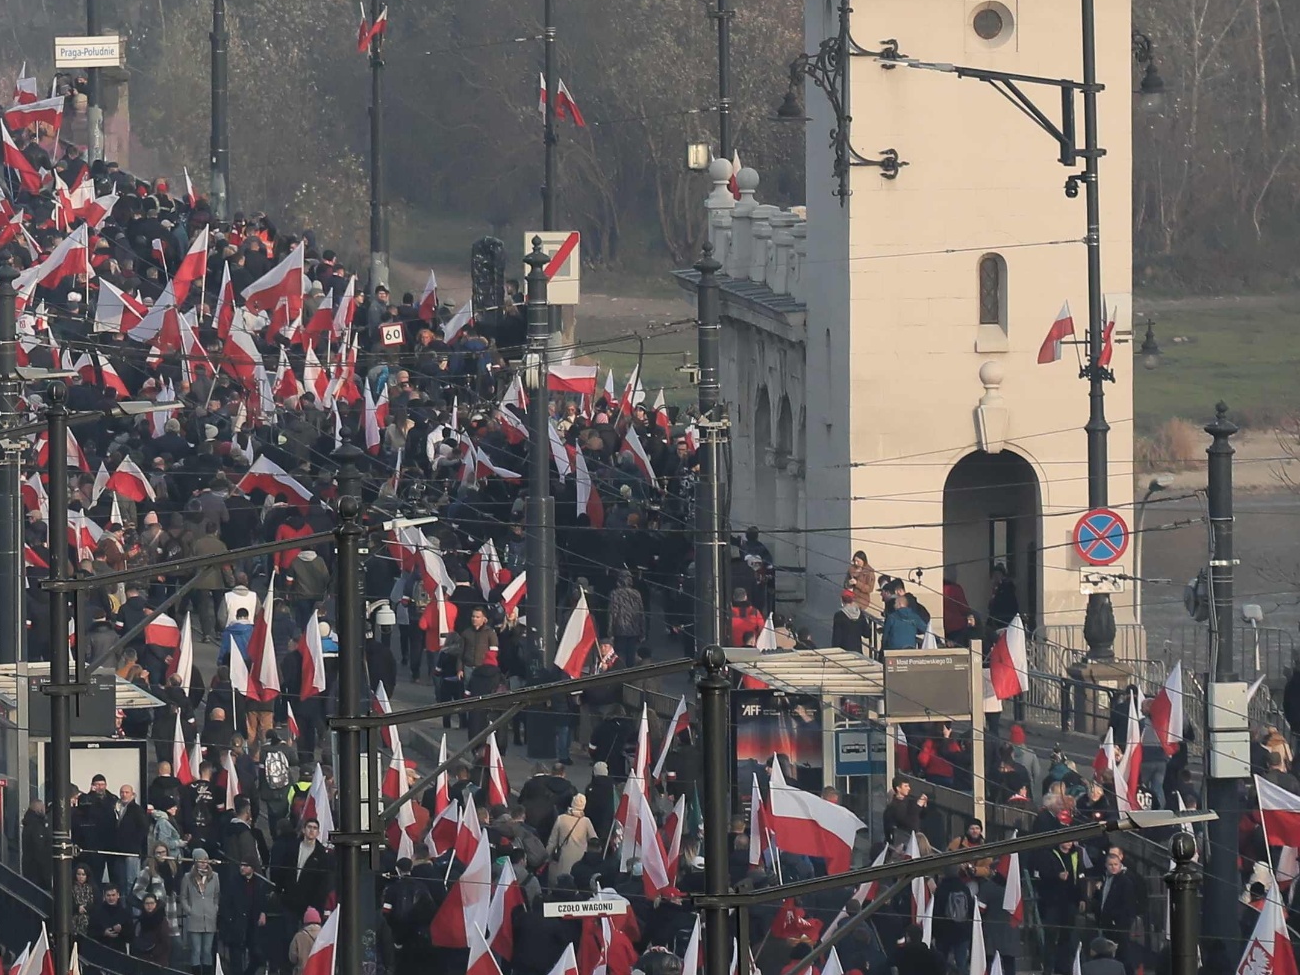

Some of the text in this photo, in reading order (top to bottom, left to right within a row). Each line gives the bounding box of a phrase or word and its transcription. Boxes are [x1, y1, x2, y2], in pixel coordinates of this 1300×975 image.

[60, 47, 114, 59] Praga-Południe
[385, 329, 401, 341] 60
[558, 903, 613, 913] CZOŁO WAGONU
